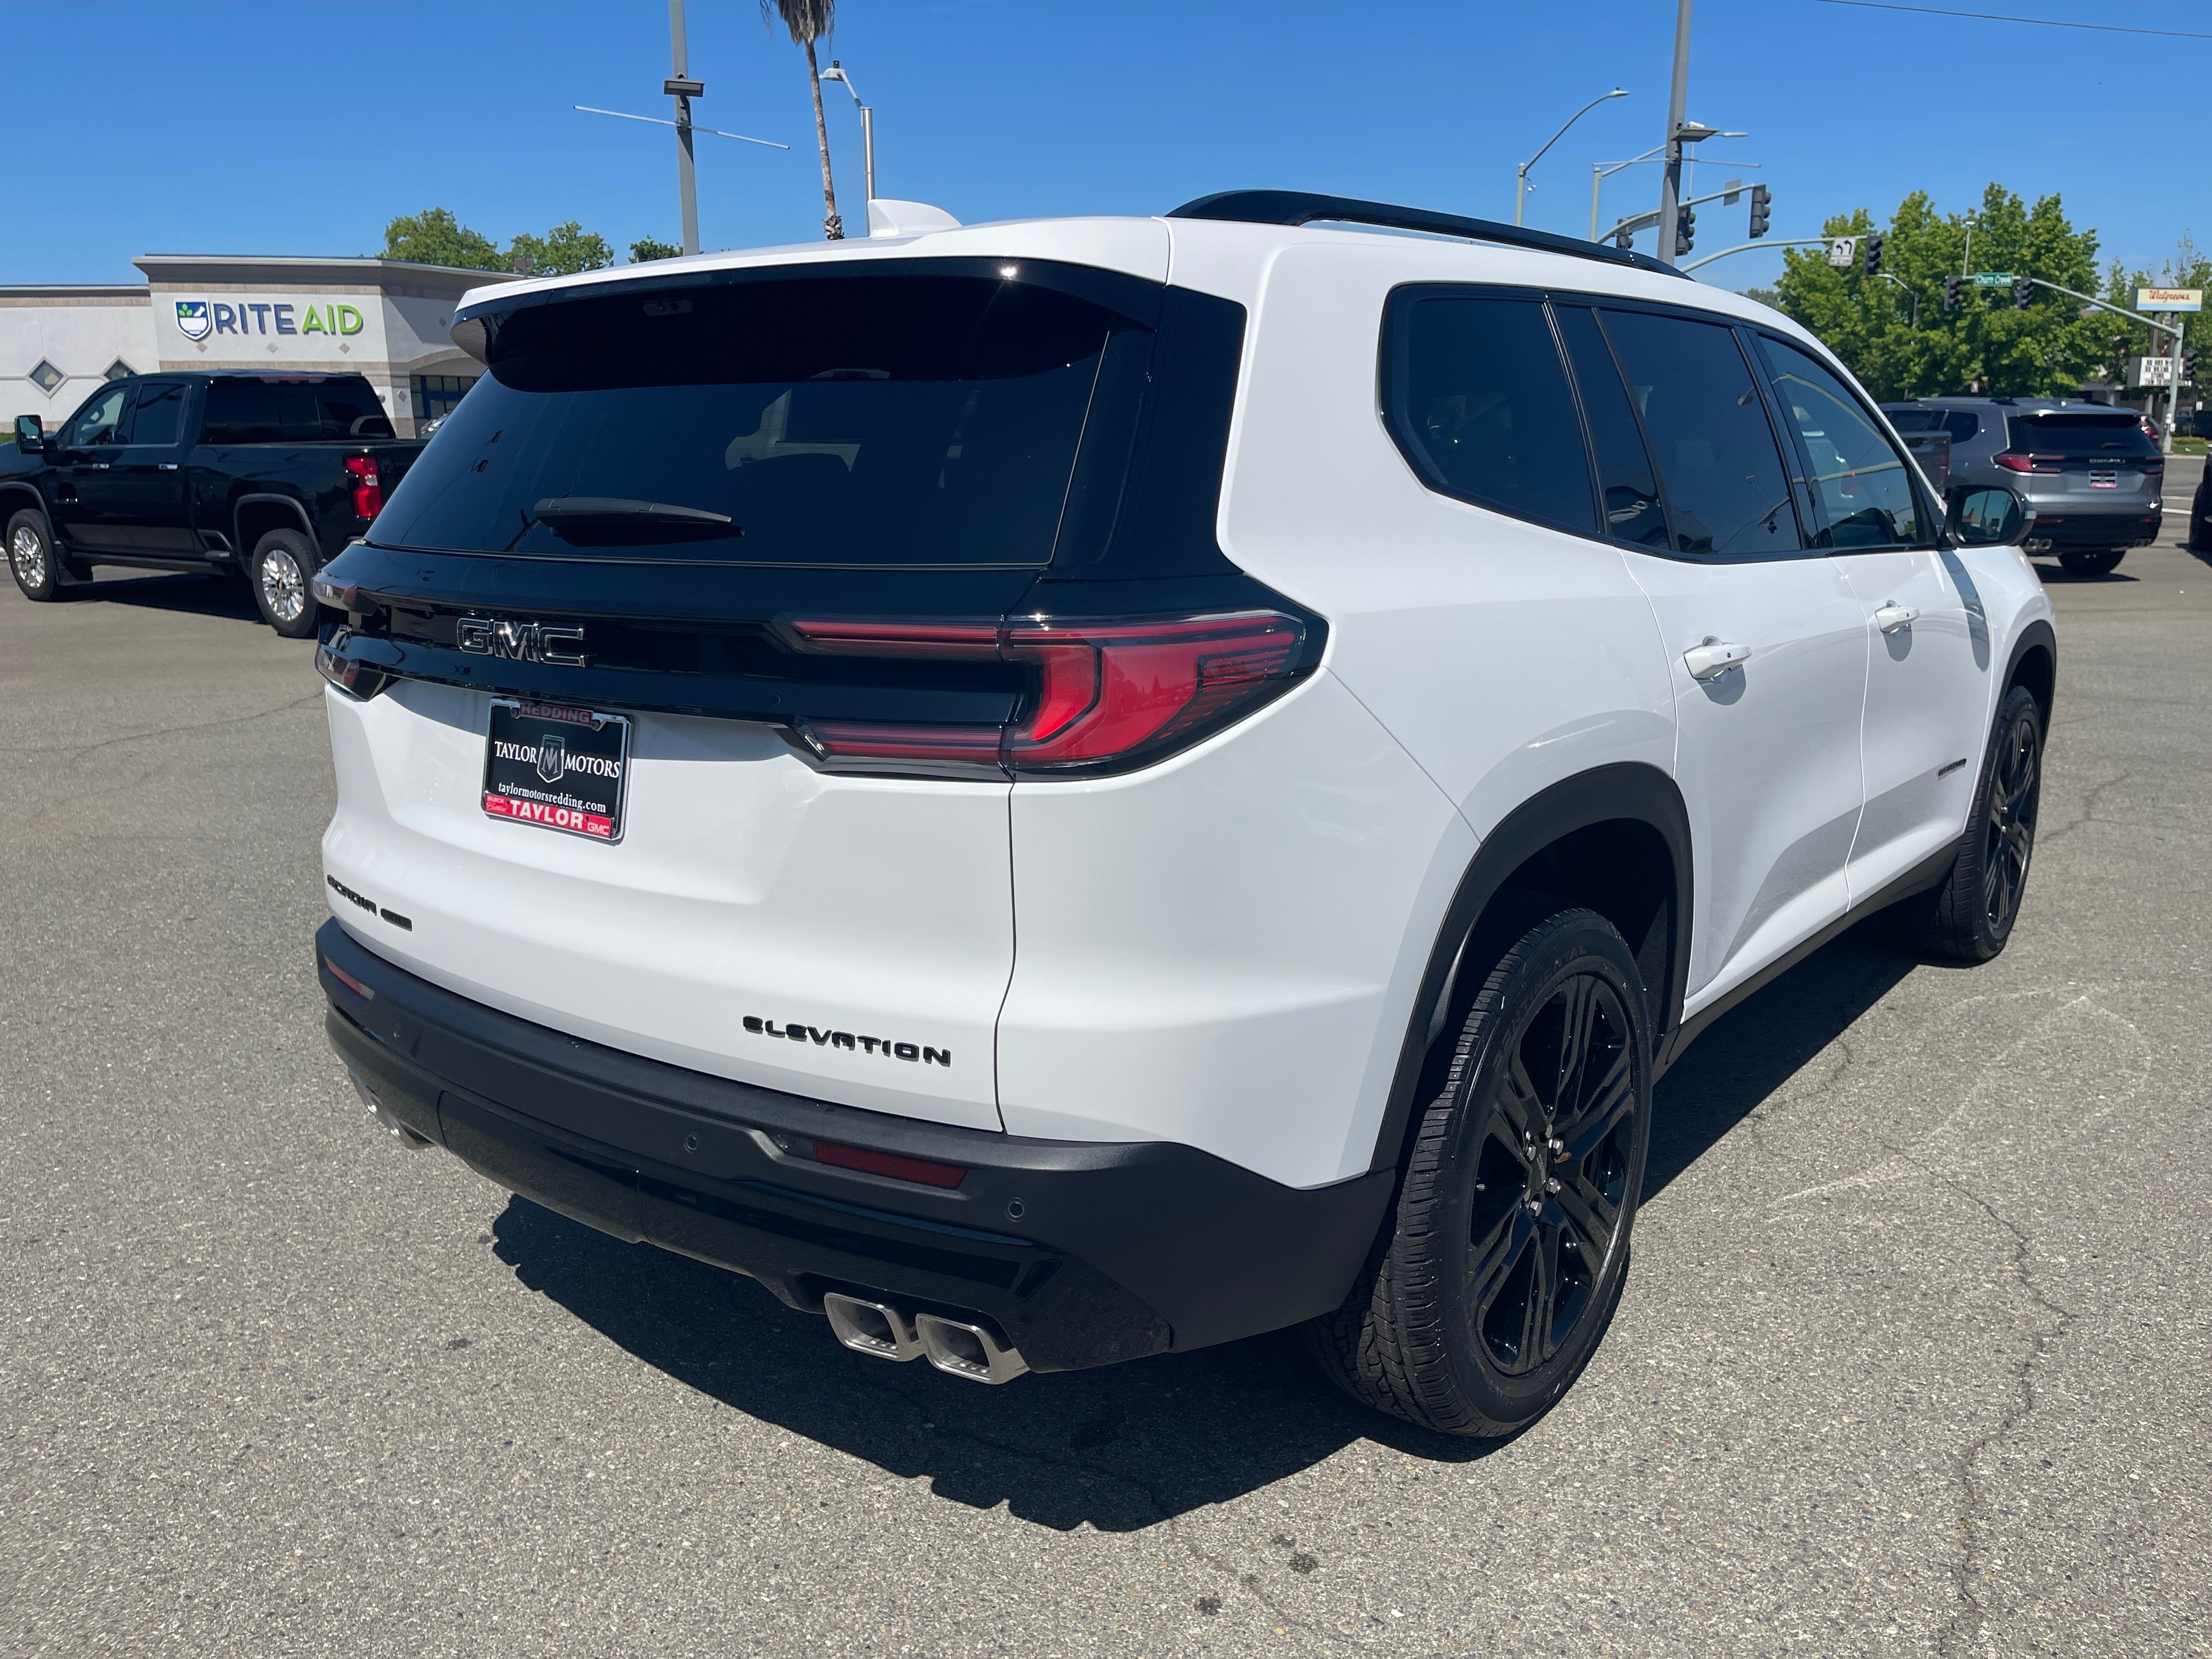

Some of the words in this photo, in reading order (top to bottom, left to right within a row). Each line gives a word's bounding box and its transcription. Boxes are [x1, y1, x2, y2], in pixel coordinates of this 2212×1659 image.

[2149, 289, 2190, 302] Walgreens
[213, 303, 297, 334] RITE
[302, 304, 363, 335] AID
[457, 618, 585, 667] GMC
[522, 705, 590, 724] REDDING
[494, 741, 538, 764] TAYLOR
[564, 753, 620, 778] MOTORS
[498, 782, 606, 813] taylormotorsredding.com
[510, 799, 584, 829] TAYLOR
[587, 823, 610, 835] GMC
[742, 1015, 951, 1067] ELEVATION
